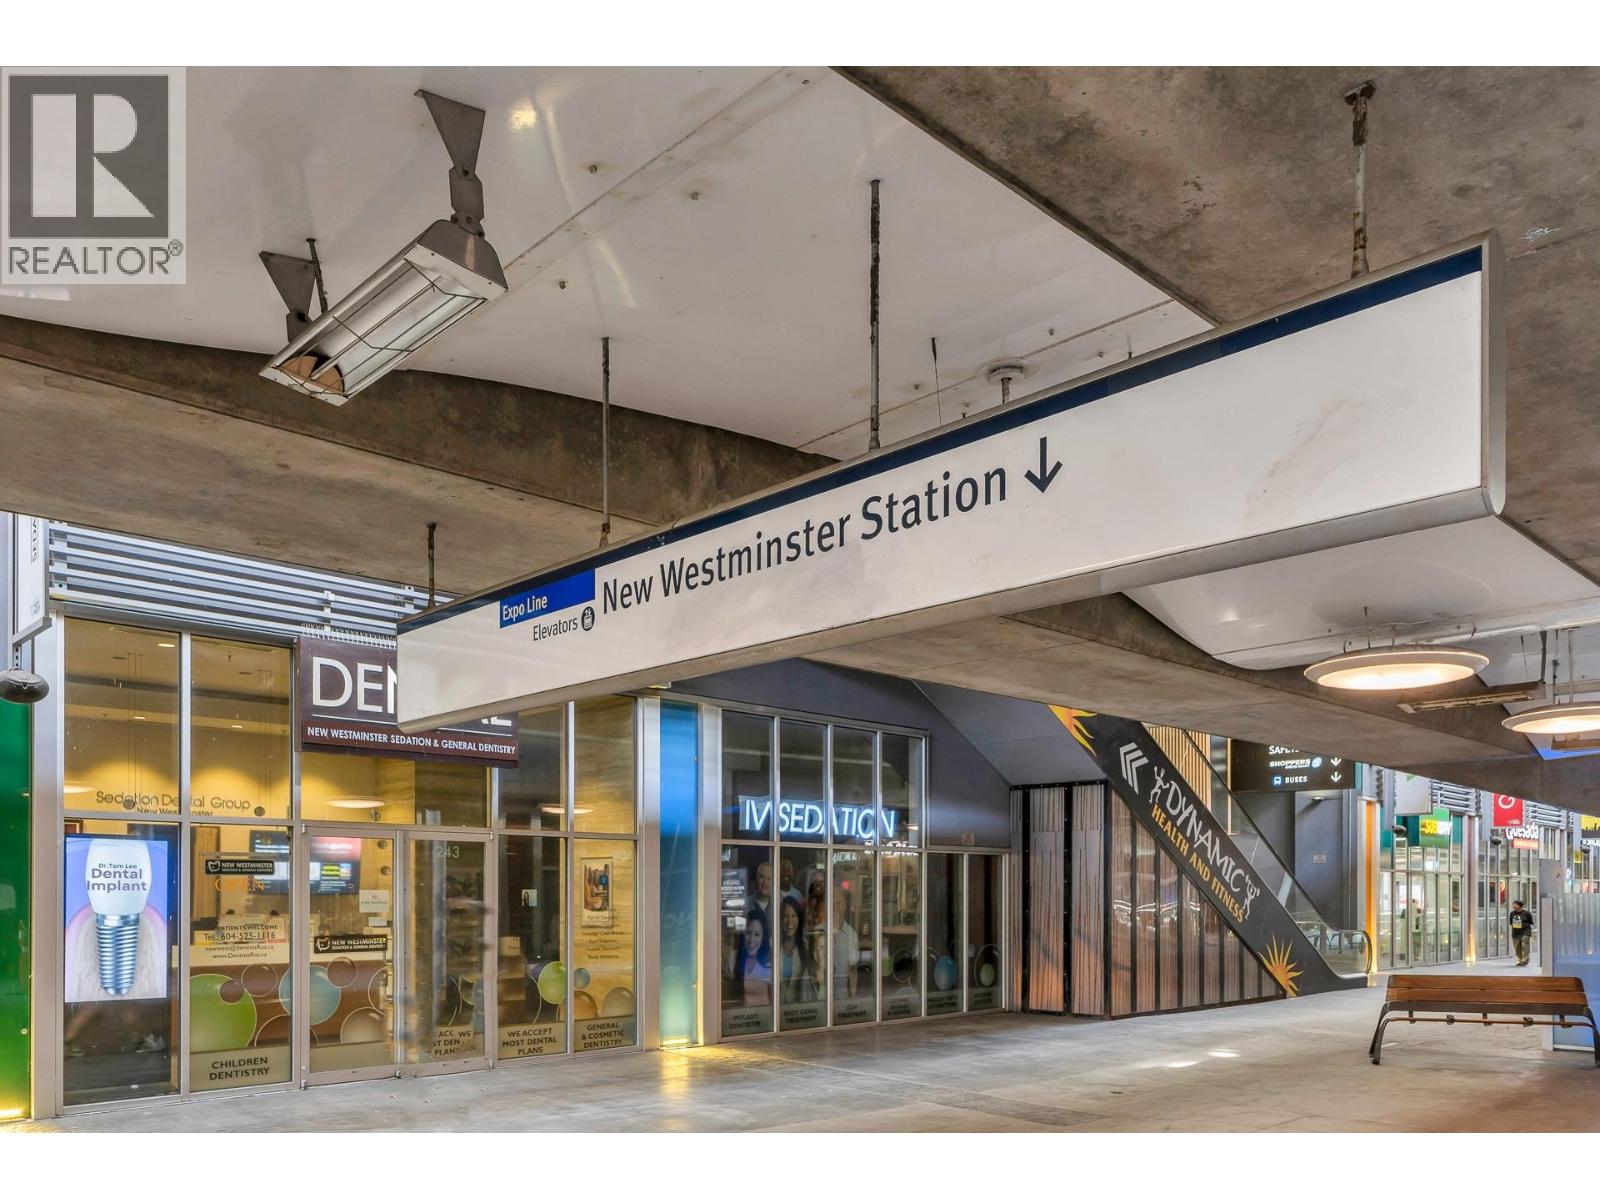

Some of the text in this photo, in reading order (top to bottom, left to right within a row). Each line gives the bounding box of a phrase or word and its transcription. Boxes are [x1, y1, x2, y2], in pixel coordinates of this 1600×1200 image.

[603, 466, 1007, 615] New Westminster Station
[502, 595, 548, 622] Expo Line
[533, 616, 578, 642] Elevators
[307, 727, 516, 755] NEW WESTMINSTER SEDATION & GENERAL DENTISTRY
[1284, 775, 1308, 784] BUSES
[161, 793, 205, 807] Detal
[210, 796, 251, 810] Group
[745, 799, 896, 839] IV SEDATION
[1166, 780, 1248, 893] DYNAMIC
[1506, 822, 1539, 840] Quesada
[437, 845, 460, 859] 243
[1151, 803, 1244, 924] HEALTH AND FITNESS
[91, 868, 143, 879] Dental
[86, 880, 148, 894] Implant
[507, 1027, 552, 1038] WE ACCEPT
[586, 1022, 620, 1031] GENERAL
[502, 1036, 558, 1047] MOST DENTAL
[588, 1029, 625, 1040] COSMETIC
[517, 1046, 544, 1056] PLANS
[583, 1039, 623, 1049] DENTISTRY
[211, 1056, 268, 1070] CHILDREN
[209, 1066, 270, 1081] DENTISTRY
